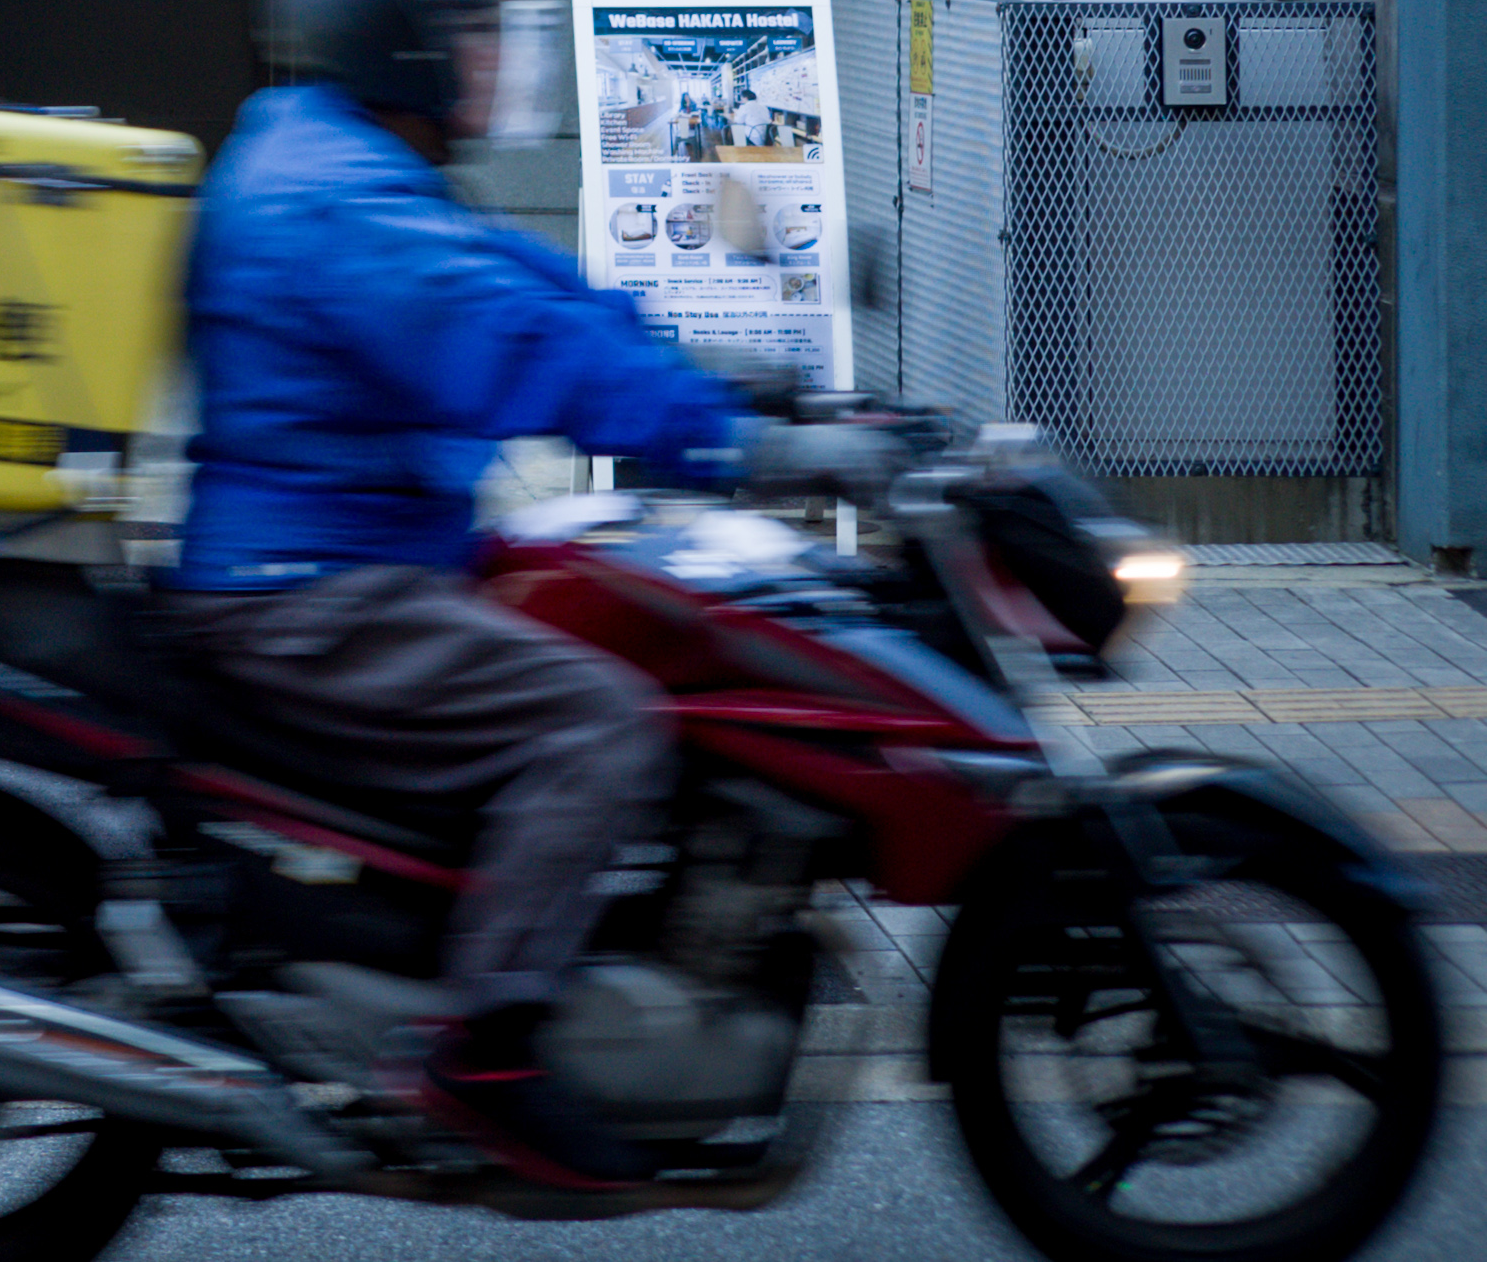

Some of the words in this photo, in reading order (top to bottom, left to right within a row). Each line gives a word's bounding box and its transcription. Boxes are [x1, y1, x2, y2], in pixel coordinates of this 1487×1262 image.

[609, 13, 676, 28] WeBase
[678, 13, 744, 28] HAKATA
[746, 12, 799, 27] Hostel
[624, 172, 655, 184] STAY
[621, 280, 659, 288] MORNING
[685, 311, 702, 319] Stay
